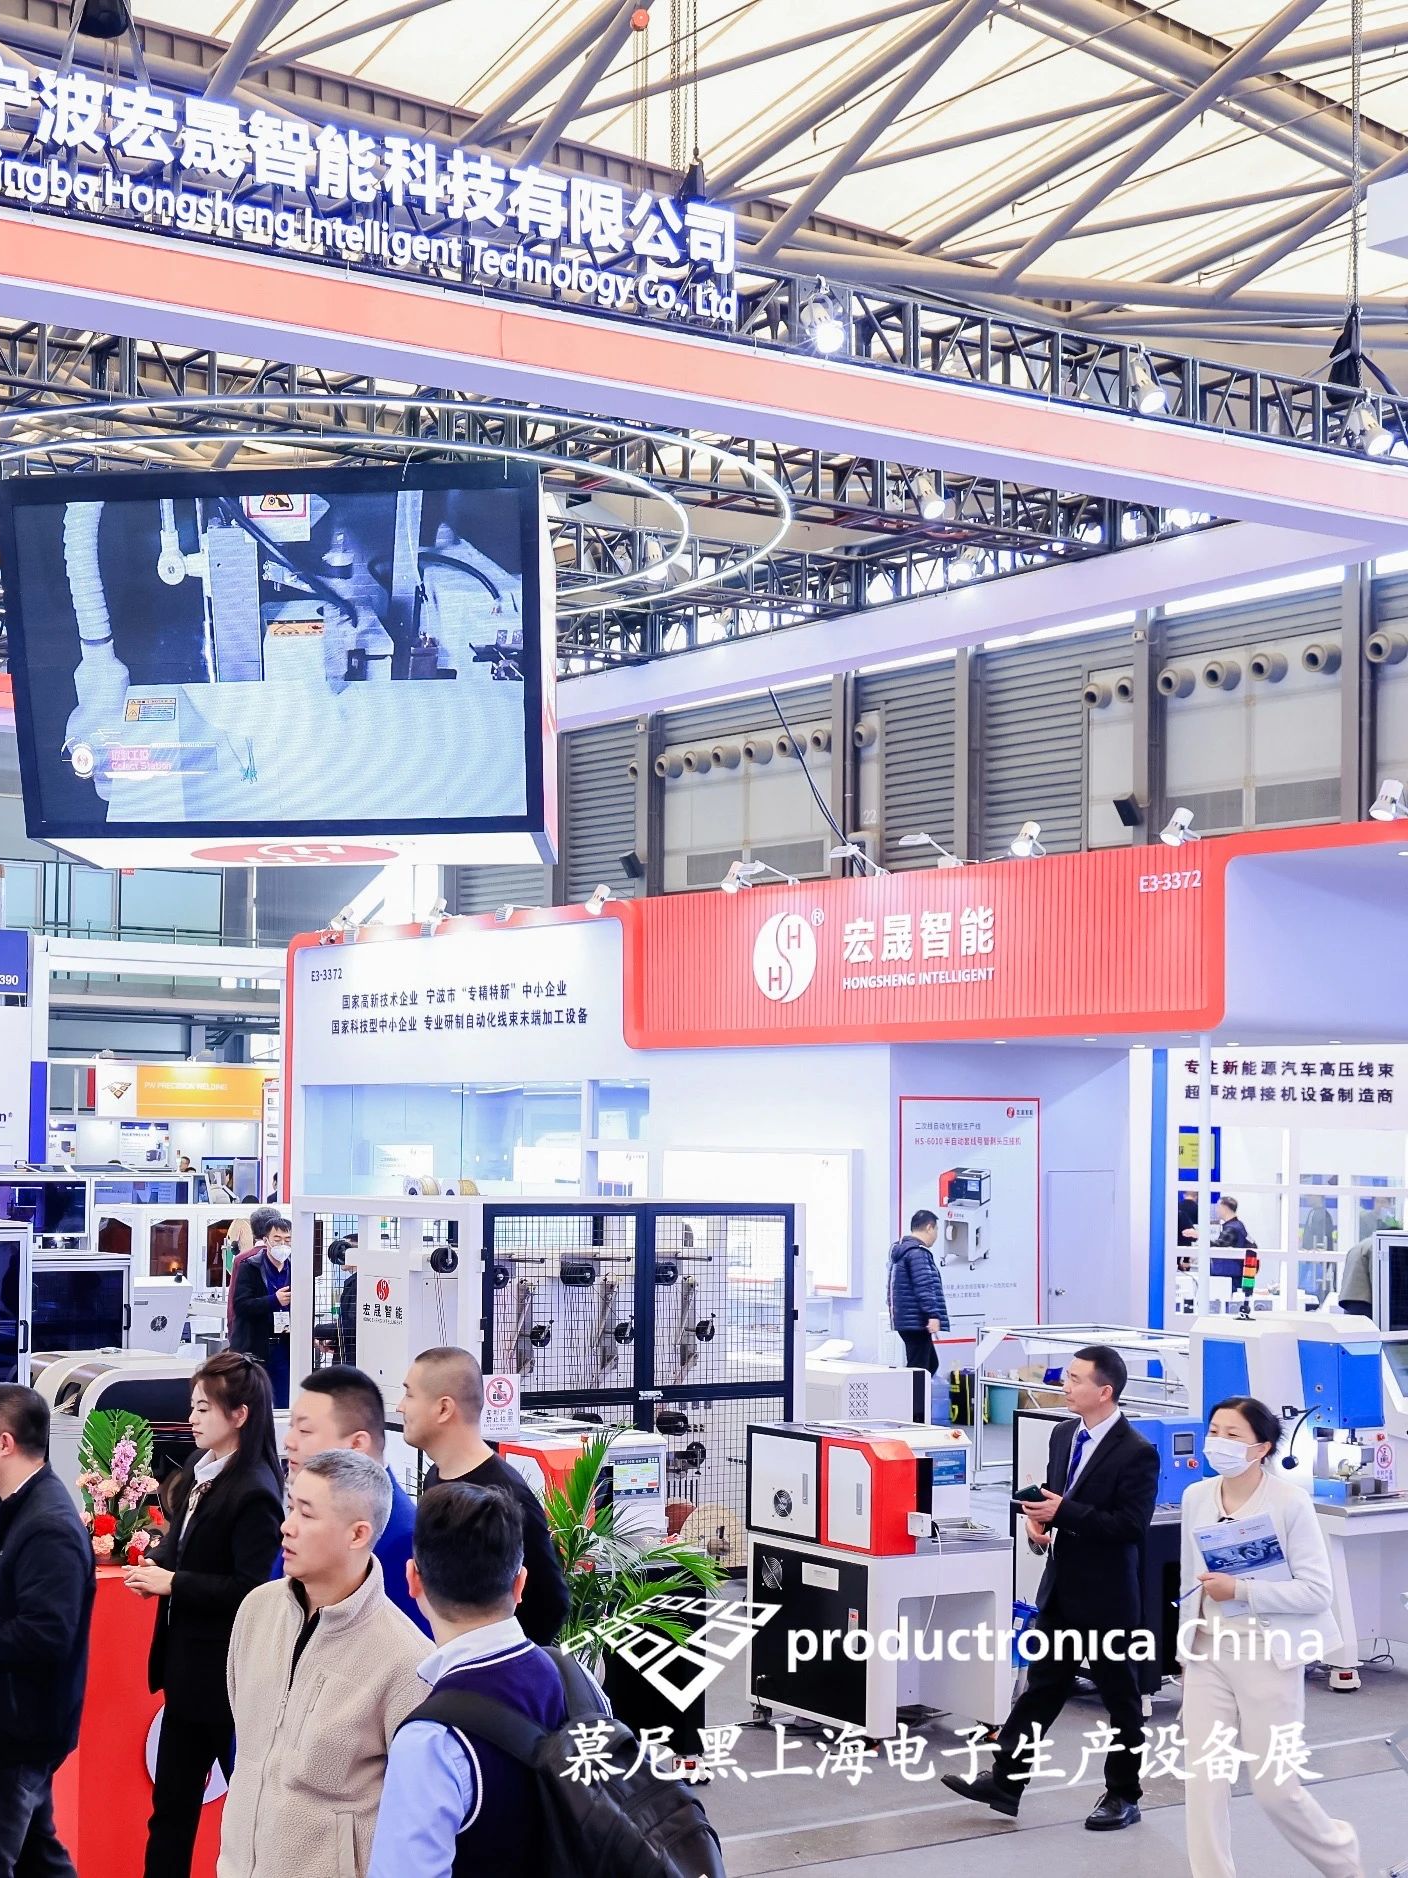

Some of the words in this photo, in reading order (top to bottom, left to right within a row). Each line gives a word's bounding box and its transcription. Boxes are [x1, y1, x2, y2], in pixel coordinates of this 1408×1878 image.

[103, 164, 301, 247] Hongsheng
[304, 203, 461, 270] Intelligent
[468, 239, 635, 308] Technology
[1138, 869, 1203, 894] E3-3372
[843, 905, 995, 965] 宏晟智能
[311, 967, 343, 982] E3-3372
[842, 972, 916, 991] HONGSHENG
[918, 967, 995, 985] INTELLIGENT
[342, 990, 419, 1010] 国家高新技术企业
[331, 1015, 418, 1035] 国家科技型中小企业
[423, 1007, 589, 1031] 专业研制自动化线束末端加工设备
[362, 1302, 403, 1320] 宏晟智能
